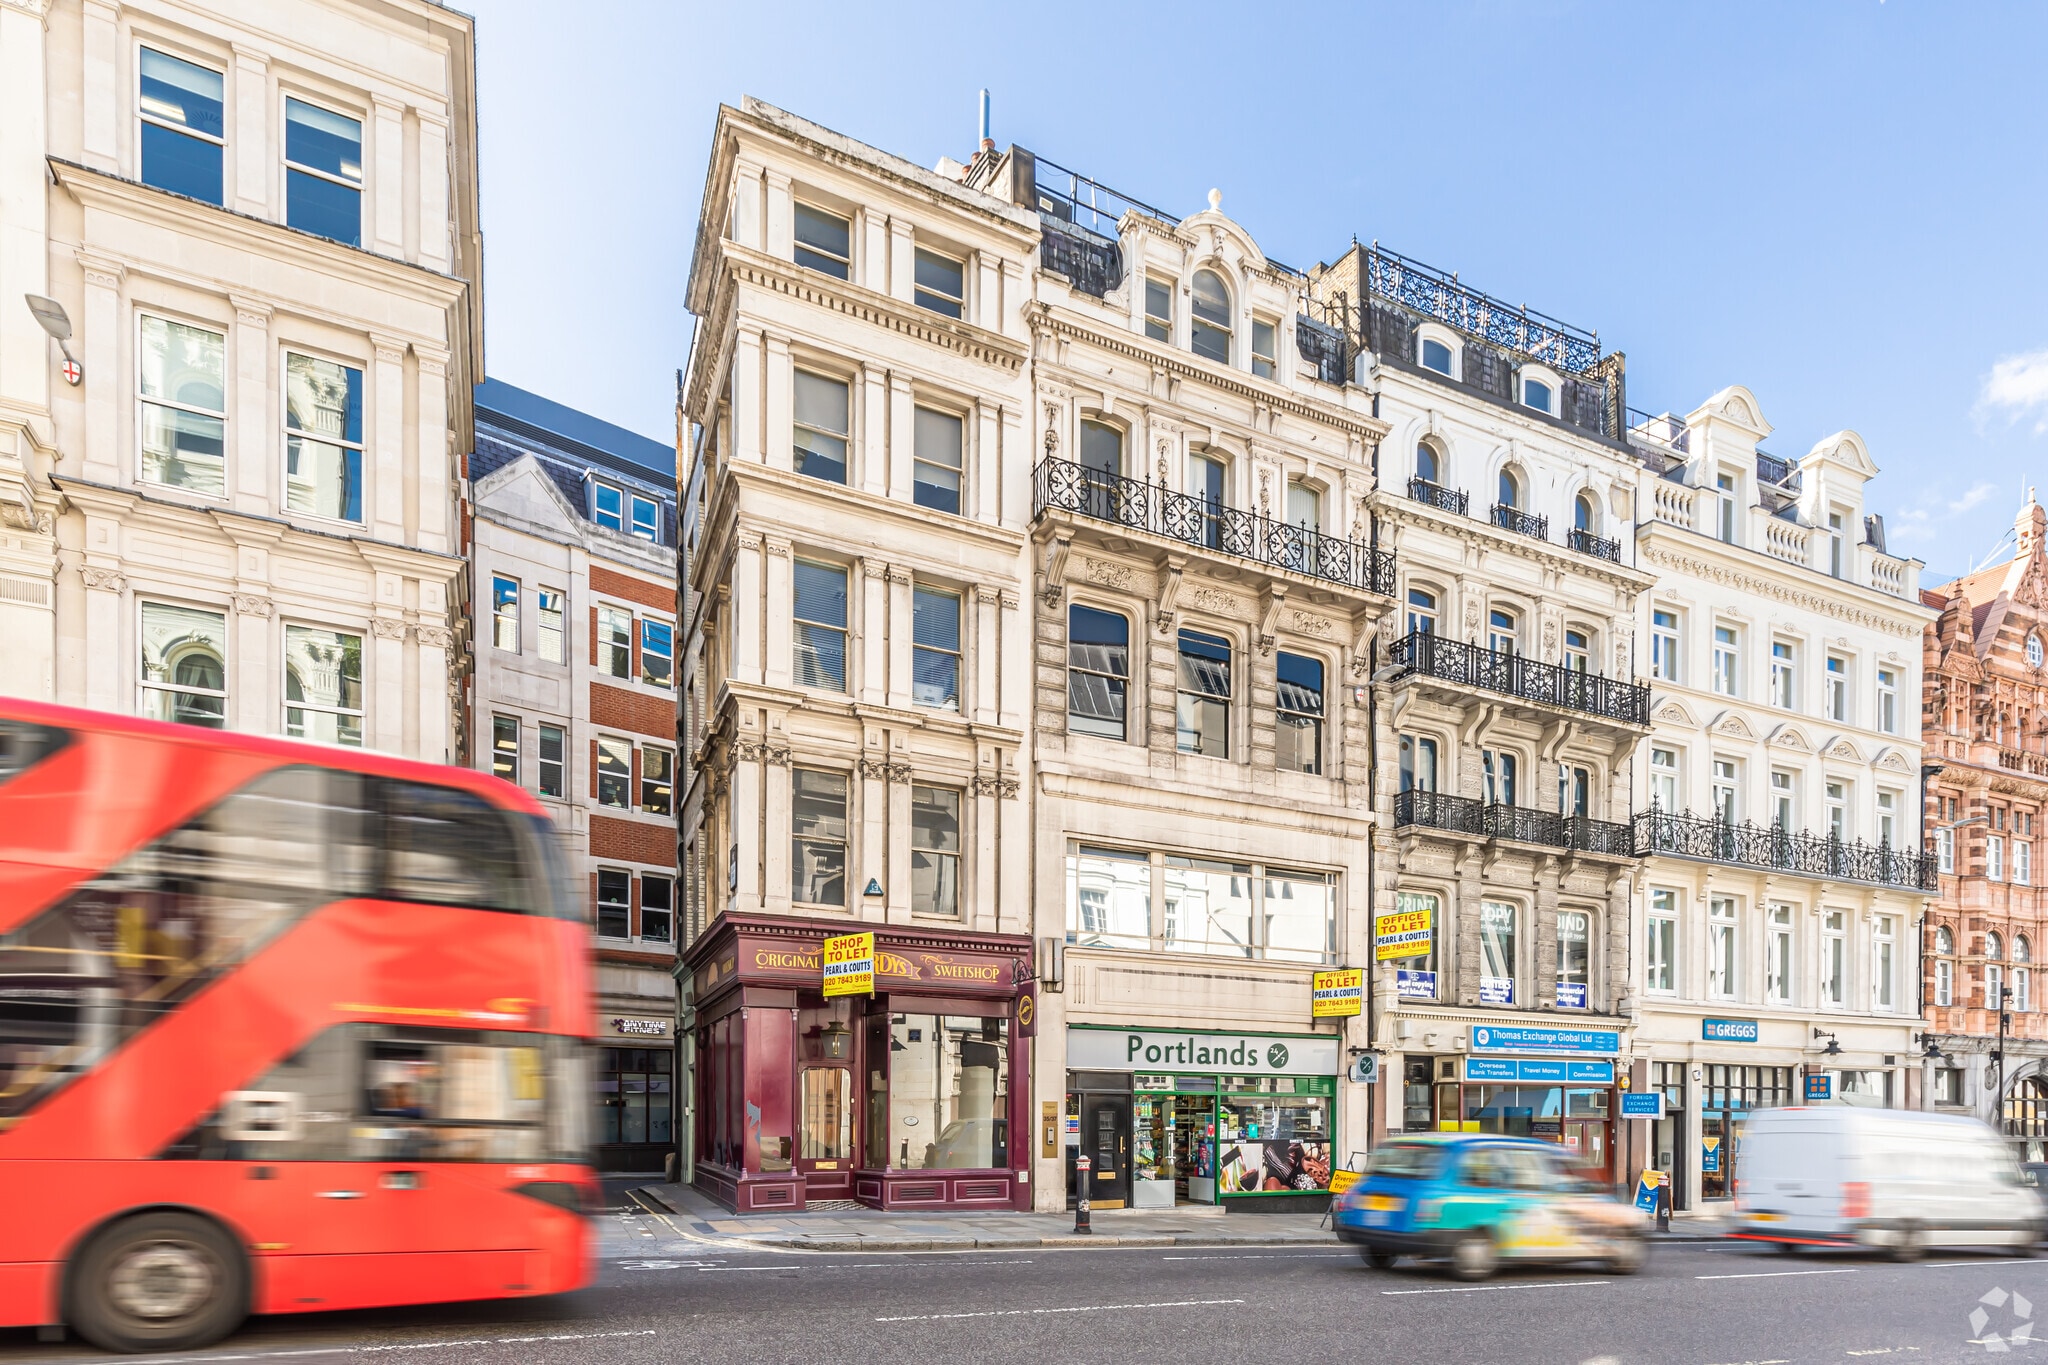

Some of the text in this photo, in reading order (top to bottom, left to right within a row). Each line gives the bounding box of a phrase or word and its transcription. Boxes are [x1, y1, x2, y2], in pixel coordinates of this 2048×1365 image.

[1383, 912, 1424, 925] OFFICE
[1381, 920, 1426, 934] TO LET
[832, 937, 863, 950] SHOP
[1378, 930, 1430, 945] PEARL & COUTTS
[1377, 945, 1390, 953] 020
[1392, 942, 1410, 950] 7843
[1411, 940, 1430, 948] 9189
[755, 952, 820, 969] ORIGINAL
[828, 947, 868, 962] TO LET
[825, 961, 871, 975] PEARL & COUTTS
[934, 964, 1000, 979] SWEETSHOP
[825, 974, 871, 986] 020 7843 9189
[1318, 976, 1357, 988] TO LET
[1314, 991, 1332, 999] PEARL
[1340, 988, 1360, 997] COUTTS
[623, 1020, 666, 1029] ANYTIME
[623, 1026, 666, 1035] FITNESS
[1716, 1024, 1756, 1038] GREGGS
[1492, 1029, 1521, 1040] Thomas
[1522, 1031, 1557, 1044] Exchange
[1557, 1033, 1580, 1042] Global
[1581, 1034, 1592, 1043] Ltd
[1127, 1035, 1258, 1066] Portlands
[1542, 1067, 1560, 1075] Money
